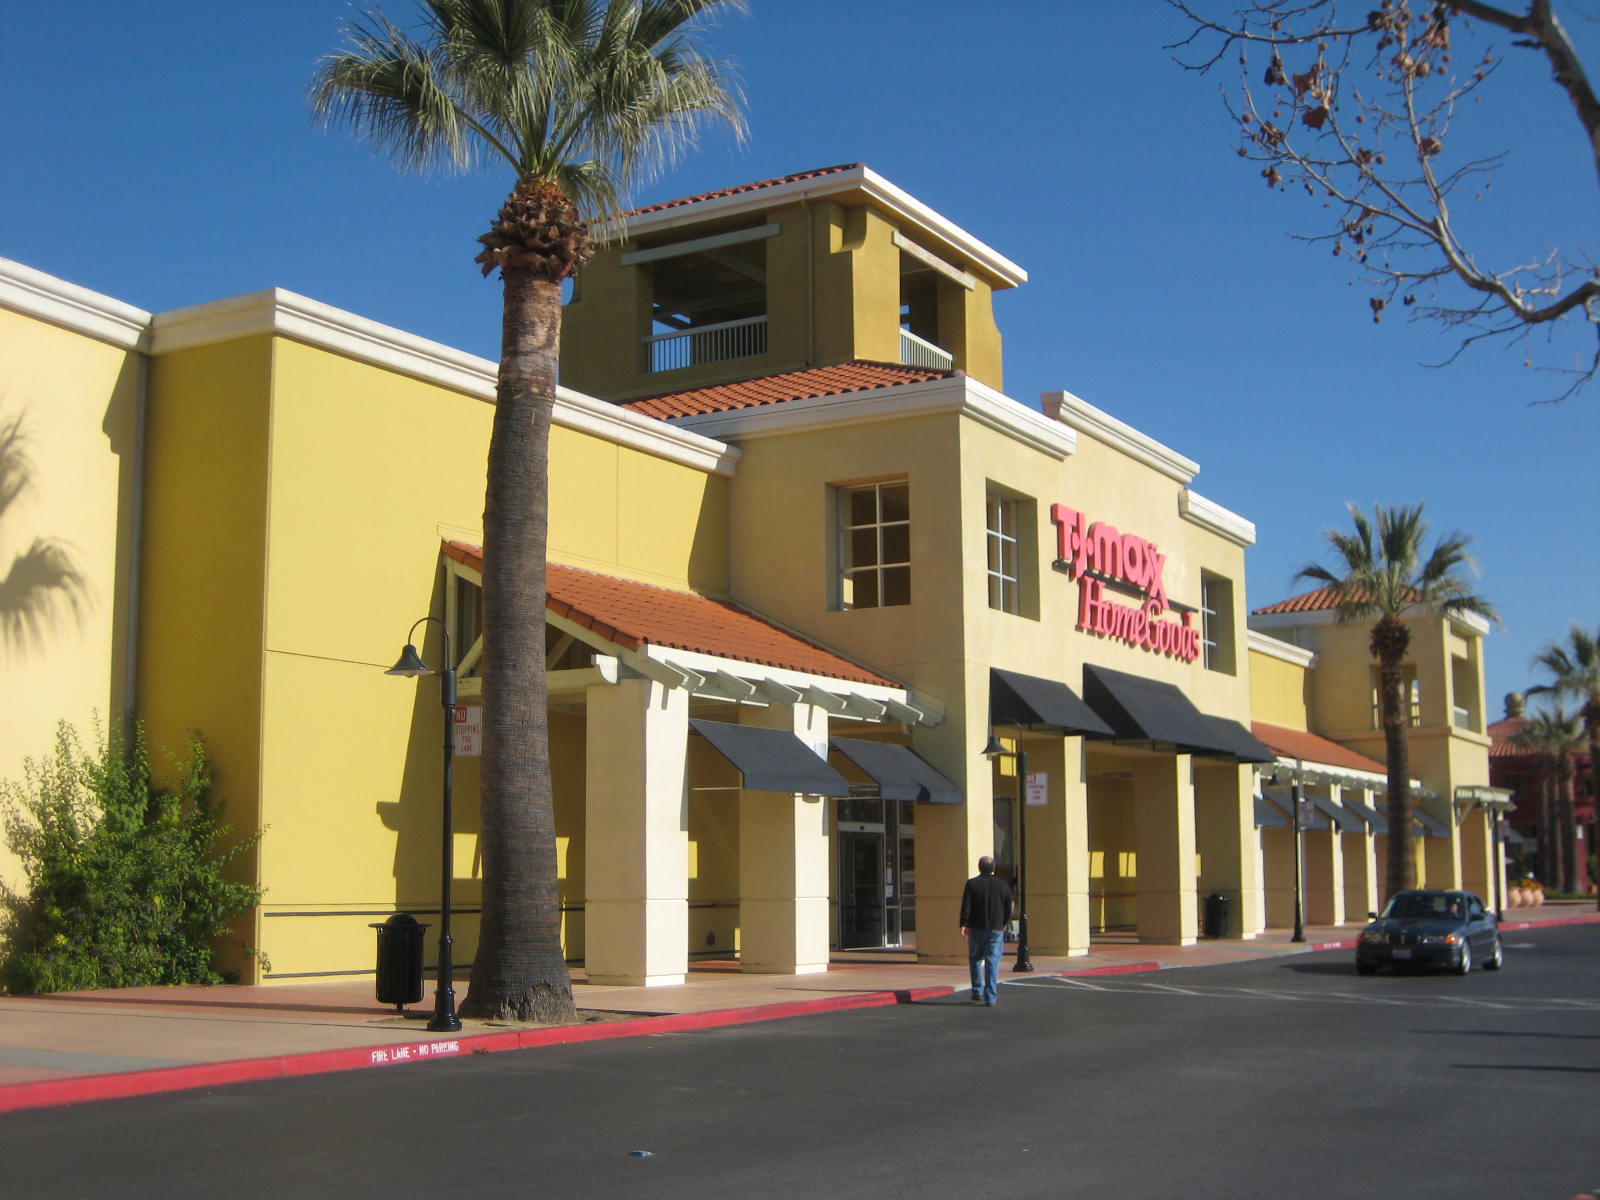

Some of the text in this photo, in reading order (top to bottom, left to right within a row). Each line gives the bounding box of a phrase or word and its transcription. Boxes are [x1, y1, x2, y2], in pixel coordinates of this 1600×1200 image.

[1077, 576, 1201, 662] HomeGoods
[455, 709, 466, 721] NO
[372, 1050, 388, 1063] FIRE
[391, 1047, 410, 1060] LANE
[419, 1045, 428, 1056] NO
[431, 1041, 459, 1054] PARKING
